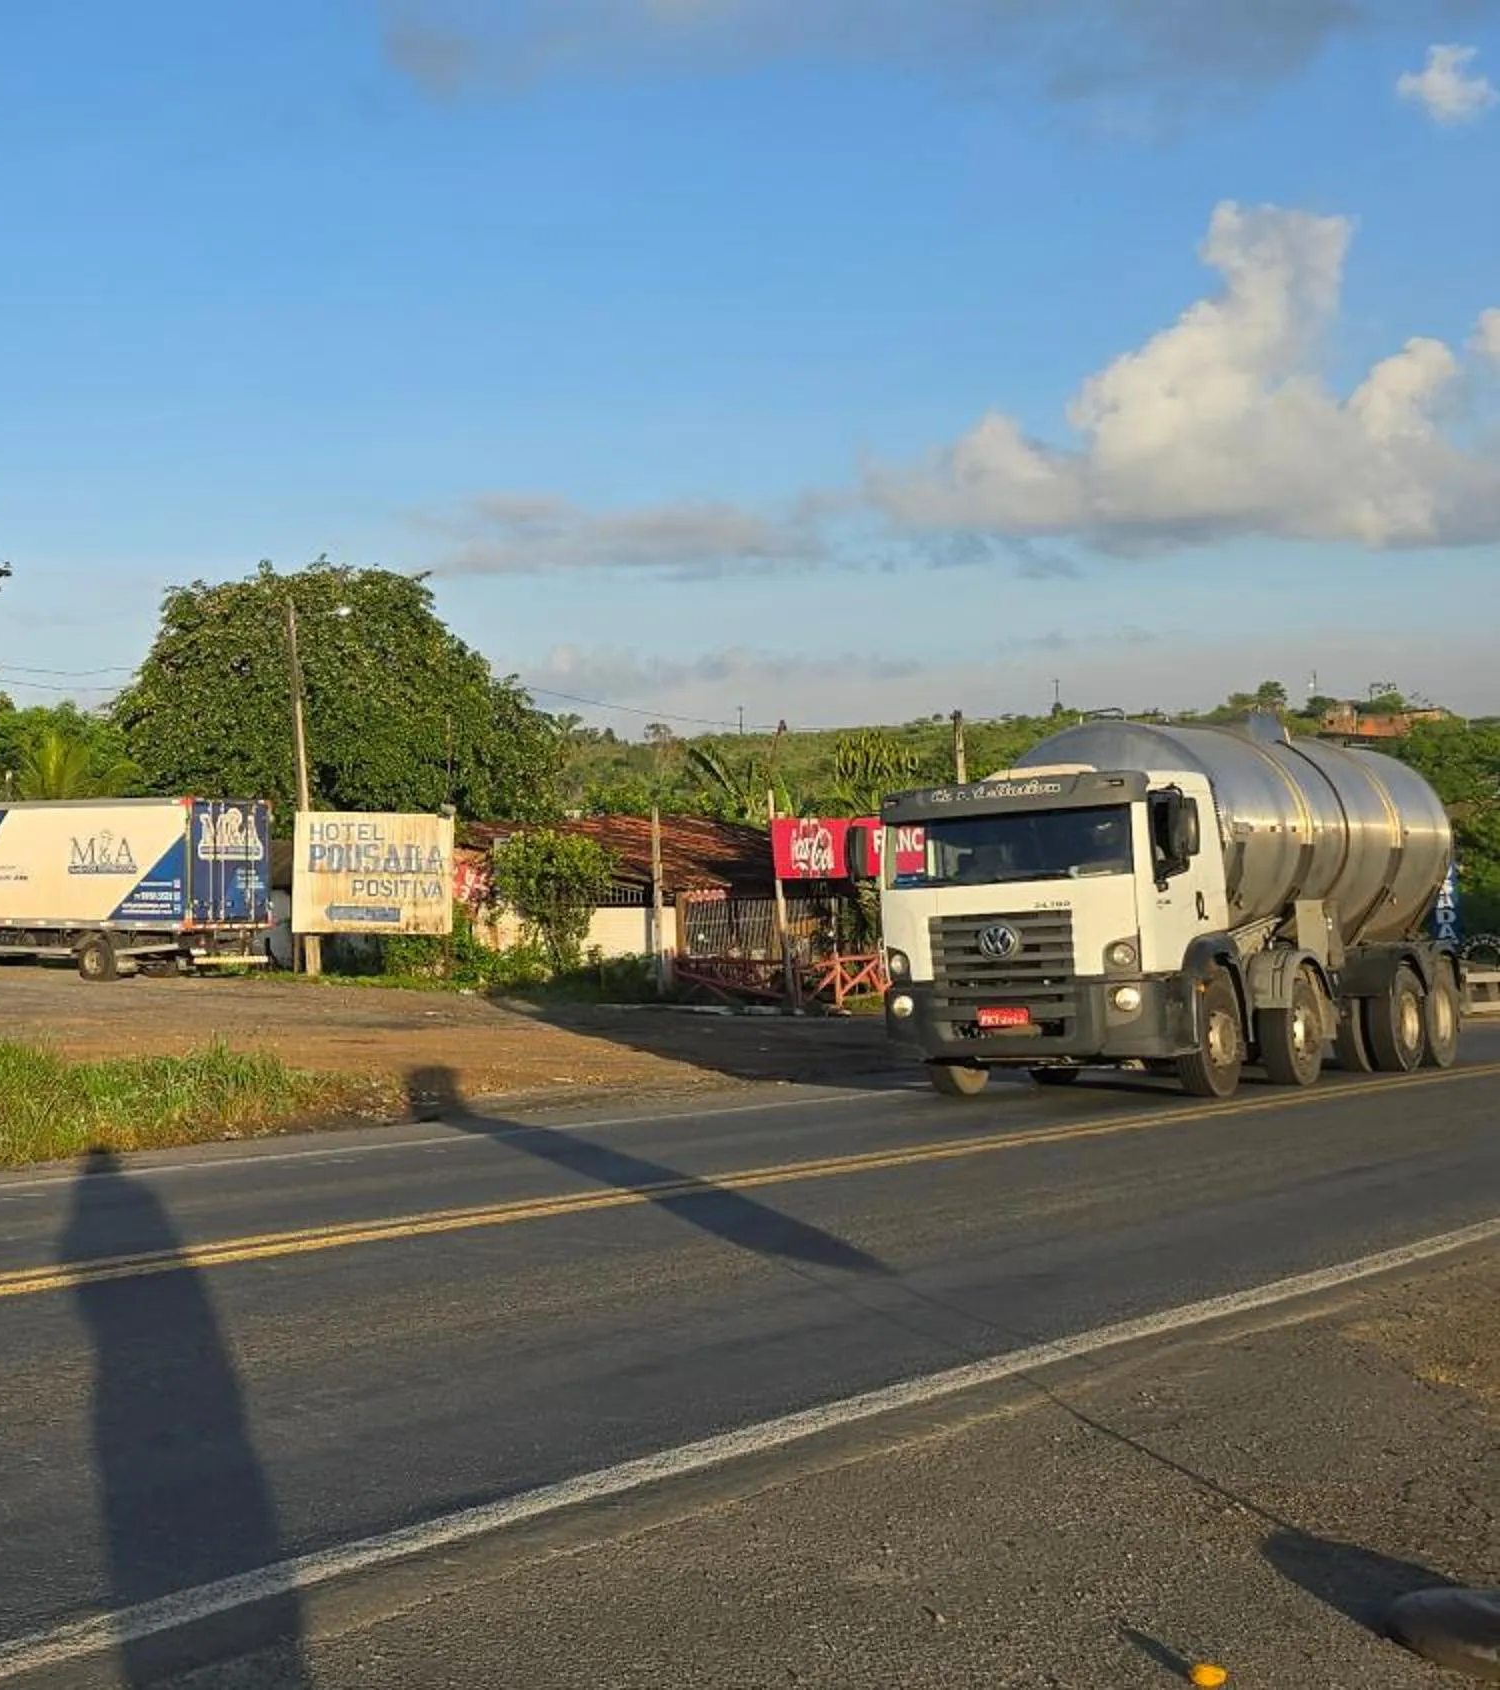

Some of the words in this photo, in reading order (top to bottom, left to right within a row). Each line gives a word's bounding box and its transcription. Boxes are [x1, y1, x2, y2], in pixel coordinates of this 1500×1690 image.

[309, 823, 385, 841] HOTEL
[70, 834, 133, 864] M&A
[308, 844, 444, 873] POUSADA
[352, 879, 443, 898] POSITIVA
